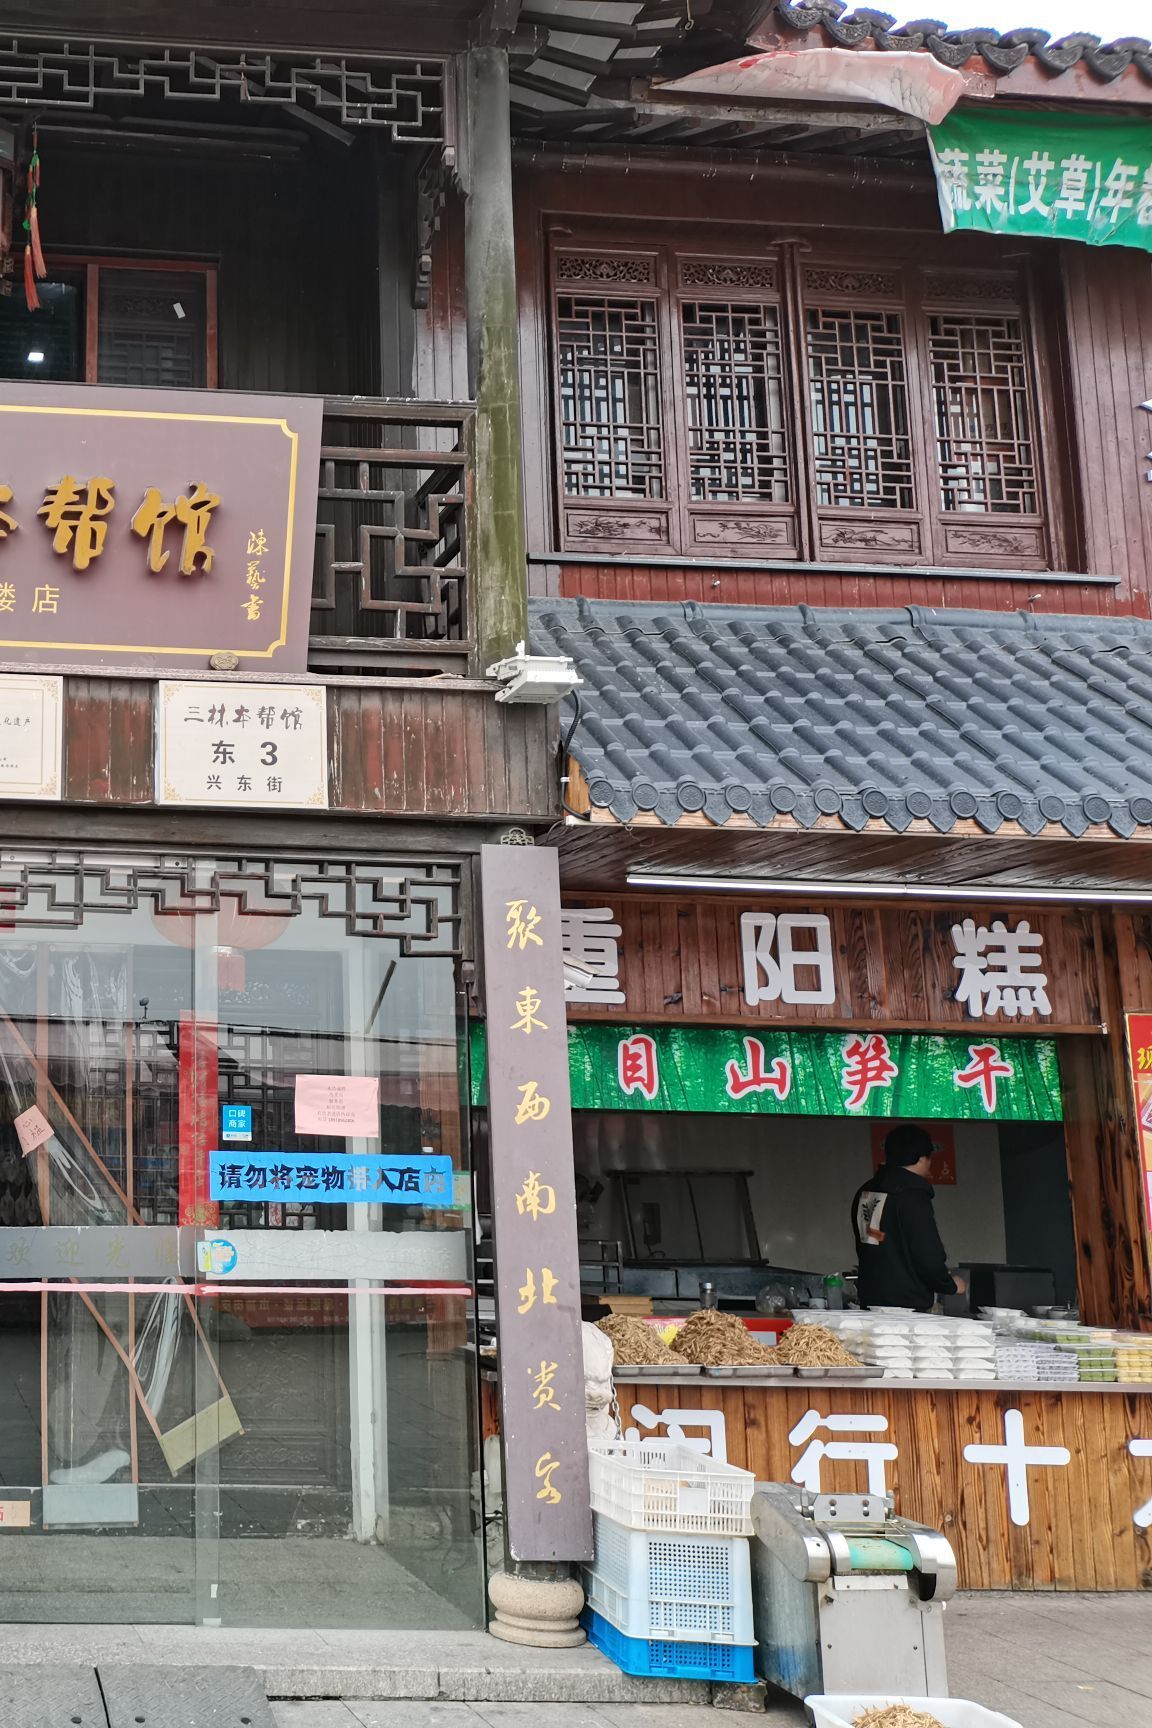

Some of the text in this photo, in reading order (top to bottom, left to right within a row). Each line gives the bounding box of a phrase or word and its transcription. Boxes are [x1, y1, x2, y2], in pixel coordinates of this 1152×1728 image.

[184, 703, 303, 730] 三林本帮馆
[211, 740, 278, 766] 东 3
[206, 774, 283, 793] 兴东街
[228, 1119, 247, 1129] 商家
[218, 1162, 448, 1193] 请勿将宠物带入店内
